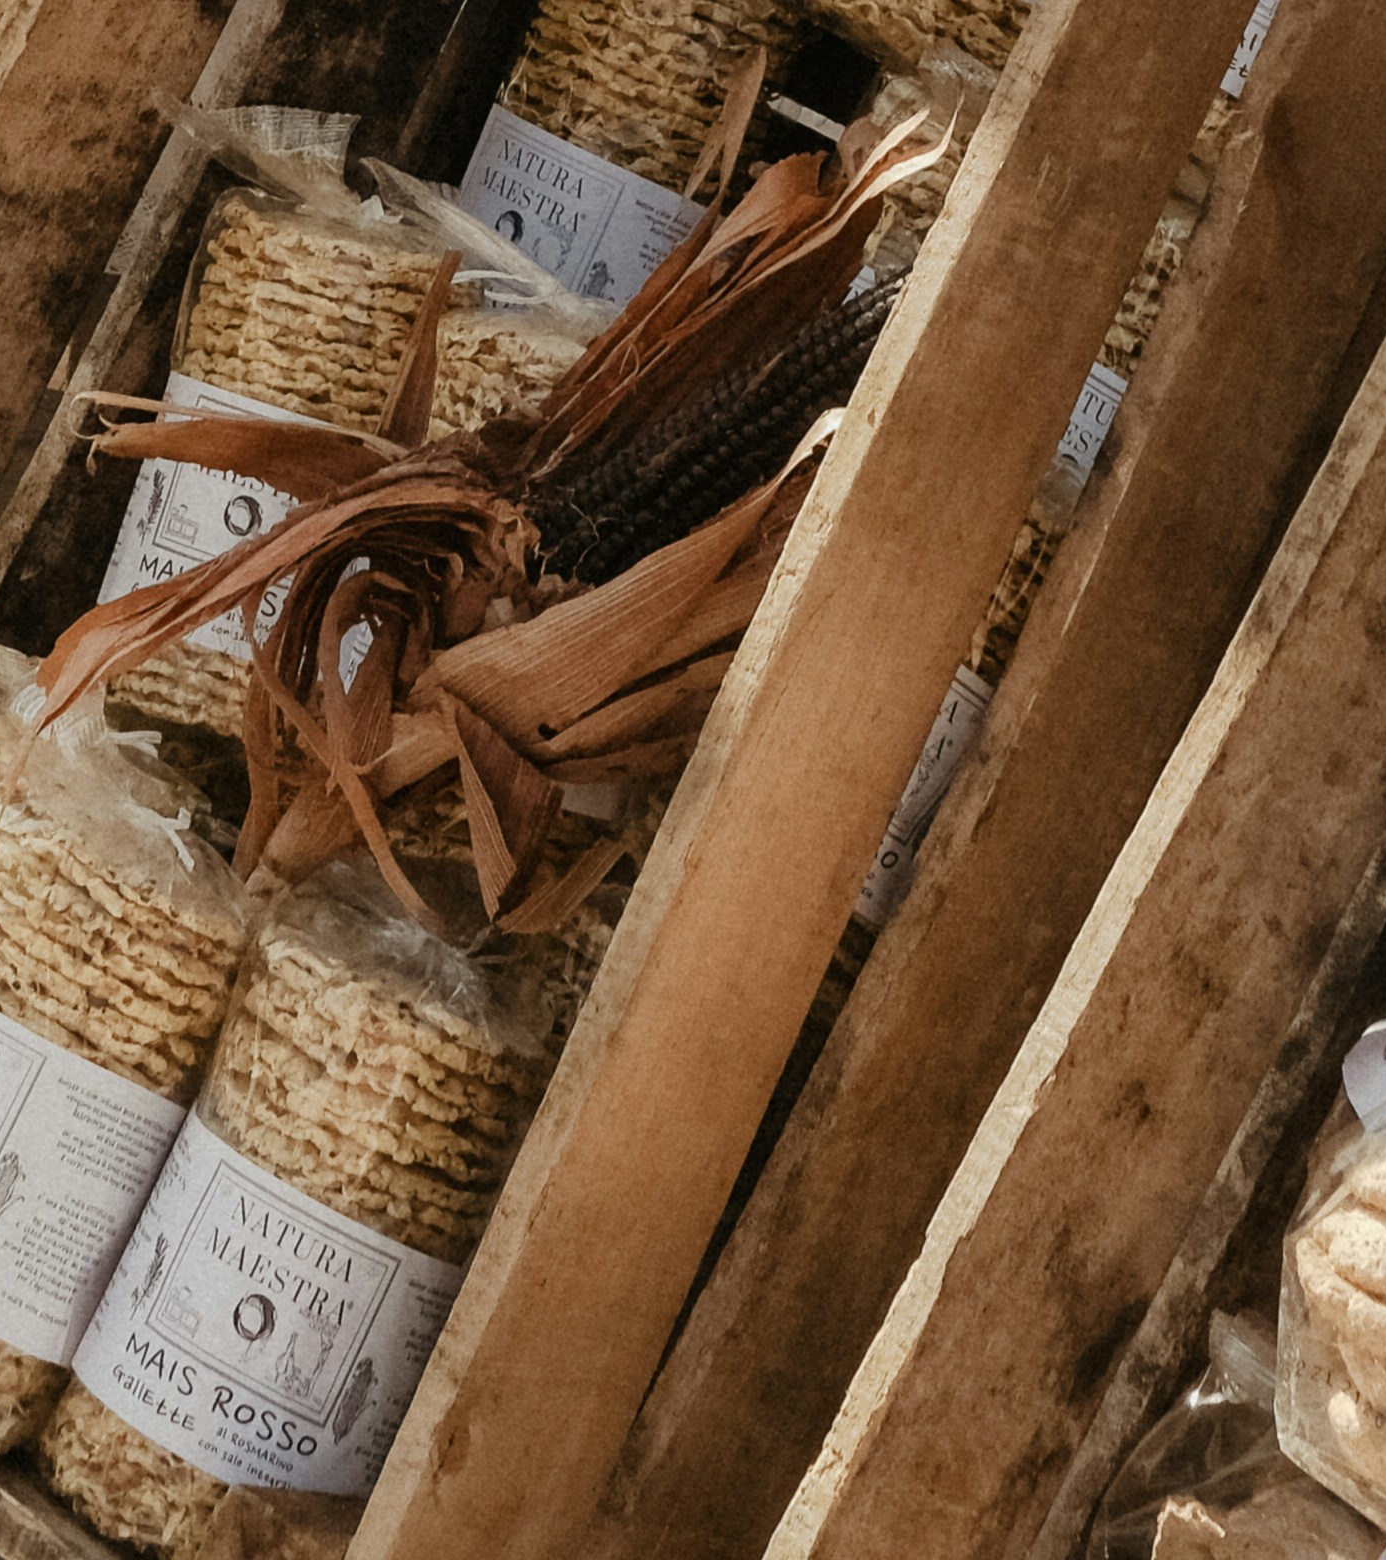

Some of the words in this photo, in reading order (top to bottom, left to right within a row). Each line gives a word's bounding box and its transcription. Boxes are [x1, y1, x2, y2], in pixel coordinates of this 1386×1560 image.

[481, 166, 581, 233] MAESTRA
[497, 139, 583, 199] NATURA
[232, 1195, 353, 1284] NATURA
[205, 1227, 346, 1326] MAESTRA
[125, 1332, 197, 1397] MAIS
[212, 1385, 318, 1456] ROSSO
[198, 1439, 218, 1454] con
[231, 1432, 294, 1472] ROSMARINO
